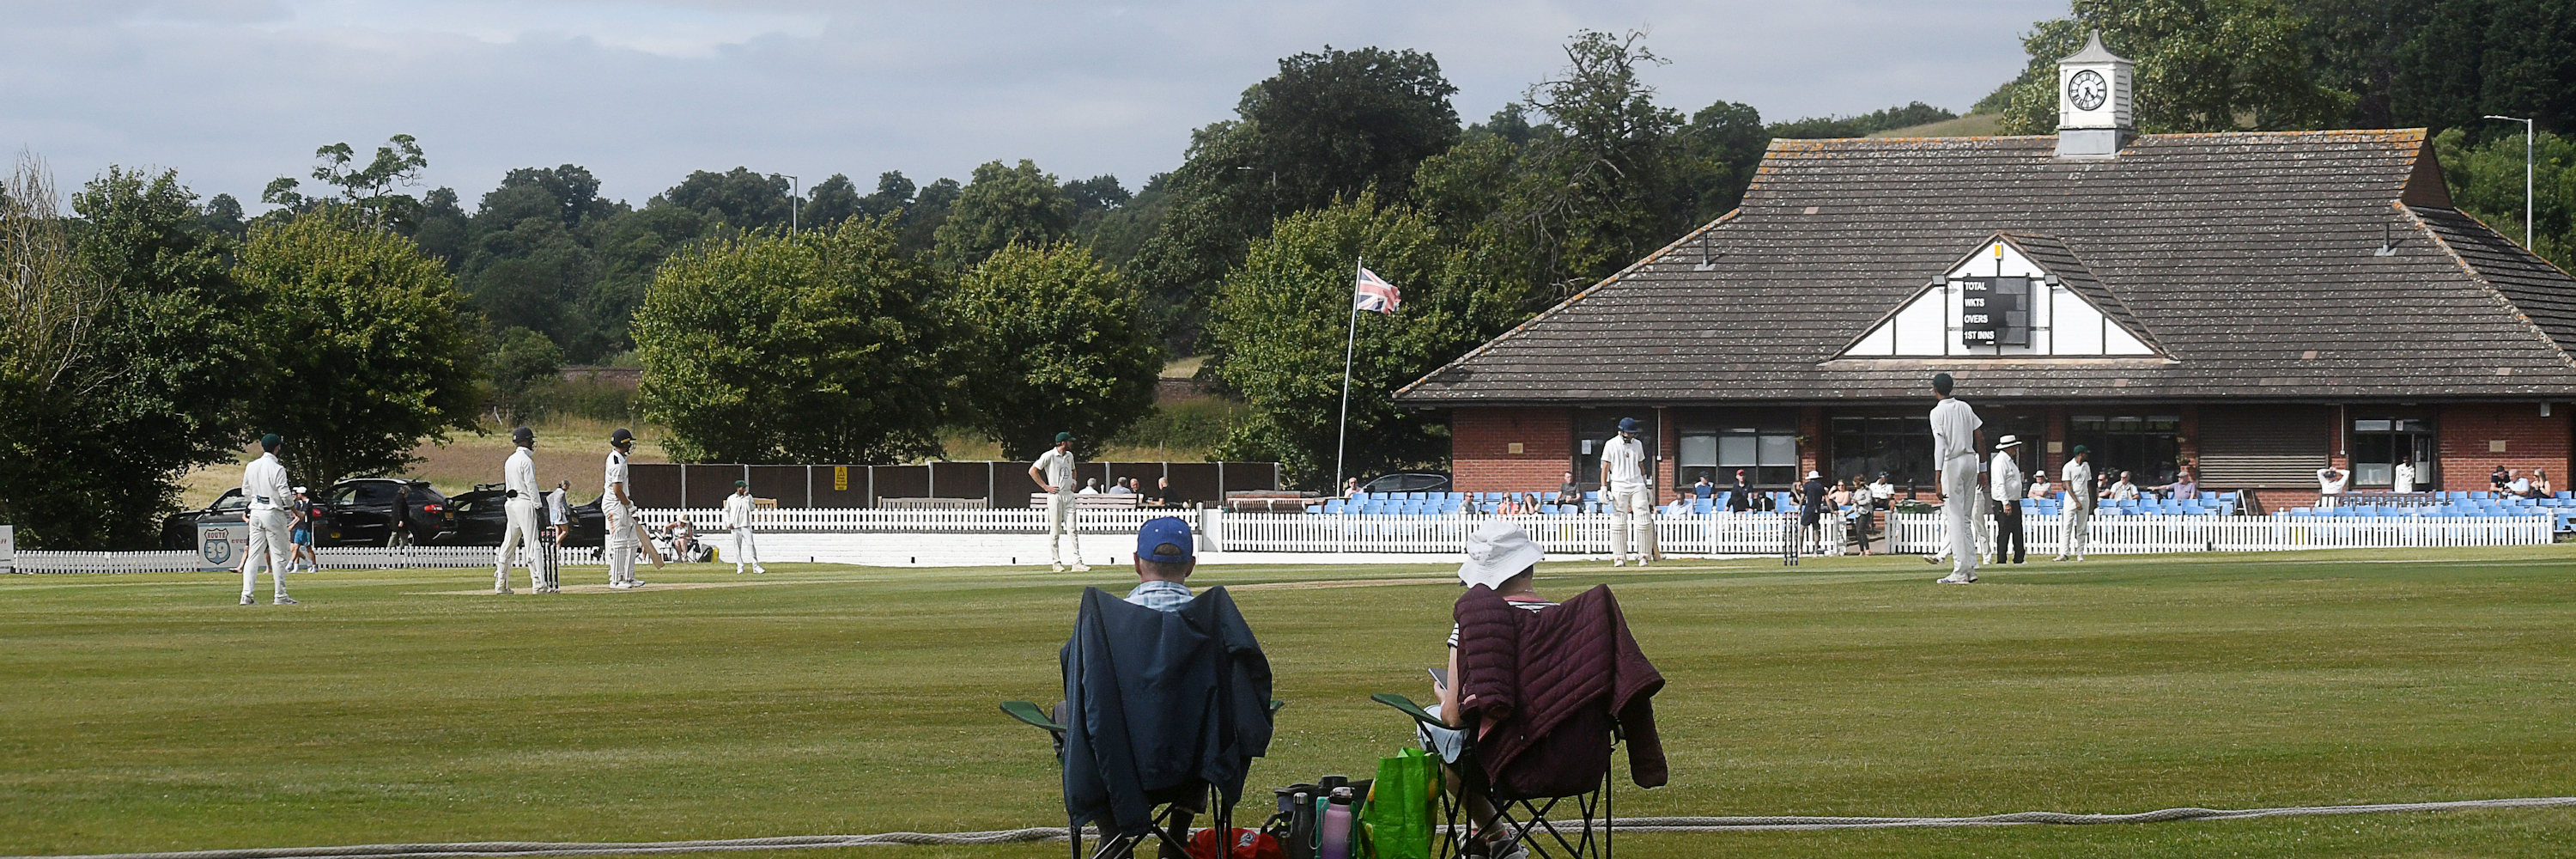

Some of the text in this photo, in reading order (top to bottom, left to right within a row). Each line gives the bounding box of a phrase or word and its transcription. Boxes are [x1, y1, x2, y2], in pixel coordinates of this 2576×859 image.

[1965, 282, 1987, 290] TOTAL
[1965, 298, 1984, 307] WKTS
[1964, 314, 1988, 323] OVERS
[1964, 331, 1995, 339] 1ST INNS
[207, 542, 228, 558] 39
